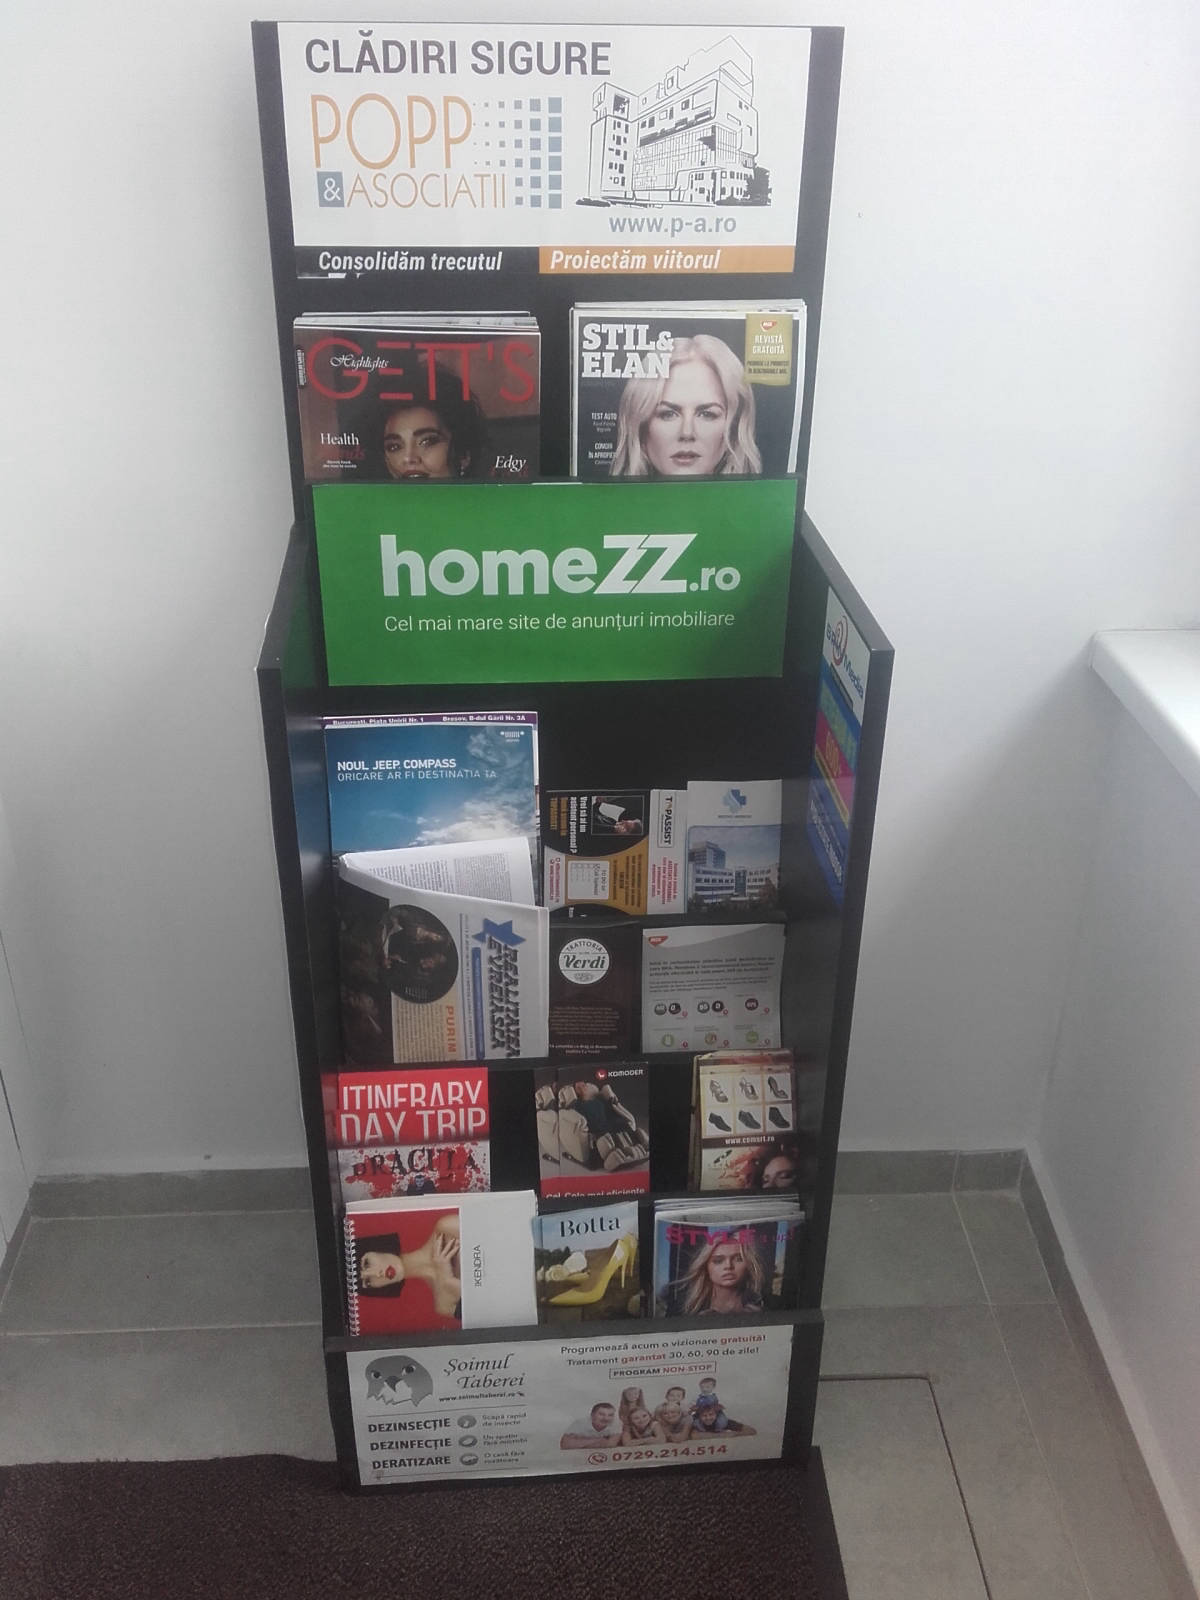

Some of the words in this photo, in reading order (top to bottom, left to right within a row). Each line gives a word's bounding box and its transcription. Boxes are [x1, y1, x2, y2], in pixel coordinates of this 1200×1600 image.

[305, 29, 457, 75] CLĂDIRI
[471, 41, 612, 76] SIGURE
[310, 93, 473, 170] POPP
[608, 215, 738, 237] www.p-a.ro
[318, 250, 425, 272] Consolidăm
[431, 251, 502, 272] trecutul
[550, 250, 649, 271] Proiectăm
[652, 250, 720, 270] viitorul
[305, 336, 535, 402] GETT'S
[329, 353, 389, 372] Highlights
[581, 352, 673, 379] ELAN
[320, 432, 360, 446] Health
[494, 454, 527, 472] Edgy
[380, 533, 741, 597] homeZZ.ro
[384, 615, 413, 632] Cel
[418, 615, 452, 631] mai
[457, 617, 502, 631] mare
[508, 613, 541, 630] site
[545, 613, 567, 629] de
[571, 612, 645, 632] anunțuri
[649, 610, 735, 628] imobiliare
[337, 760, 369, 772] NOUL
[403, 758, 457, 770] COMPASS
[337, 771, 383, 782] ORICARE
[386, 771, 402, 781] AR
[404, 770, 415, 780] FI
[563, 954, 606, 969] Verdi
[503, 944, 521, 1057] REALITATEA
[446, 1005, 457, 1053] PURIM
[340, 1111, 407, 1146] DAY
[416, 1107, 487, 1142] TRIP
[560, 1216, 621, 1237] Botta
[631, 1342, 660, 1350] acum
[671, 1339, 718, 1347] vizionare
[566, 1356, 618, 1367] Tratament
[621, 1353, 666, 1365] garantat
[687, 1350, 704, 1358] 60,
[706, 1348, 720, 1357] 90
[722, 1348, 736, 1356] de
[613, 1366, 661, 1377] PROGRAM
[662, 1364, 713, 1374] NON-STOP
[456, 1372, 526, 1389] Taberei
[368, 1418, 451, 1433] DEZINSECȚIE
[370, 1438, 451, 1452] DEZINFECȚIE
[611, 1444, 728, 1463] 0729.214.514
[372, 1455, 451, 1470] DERATIZARE
